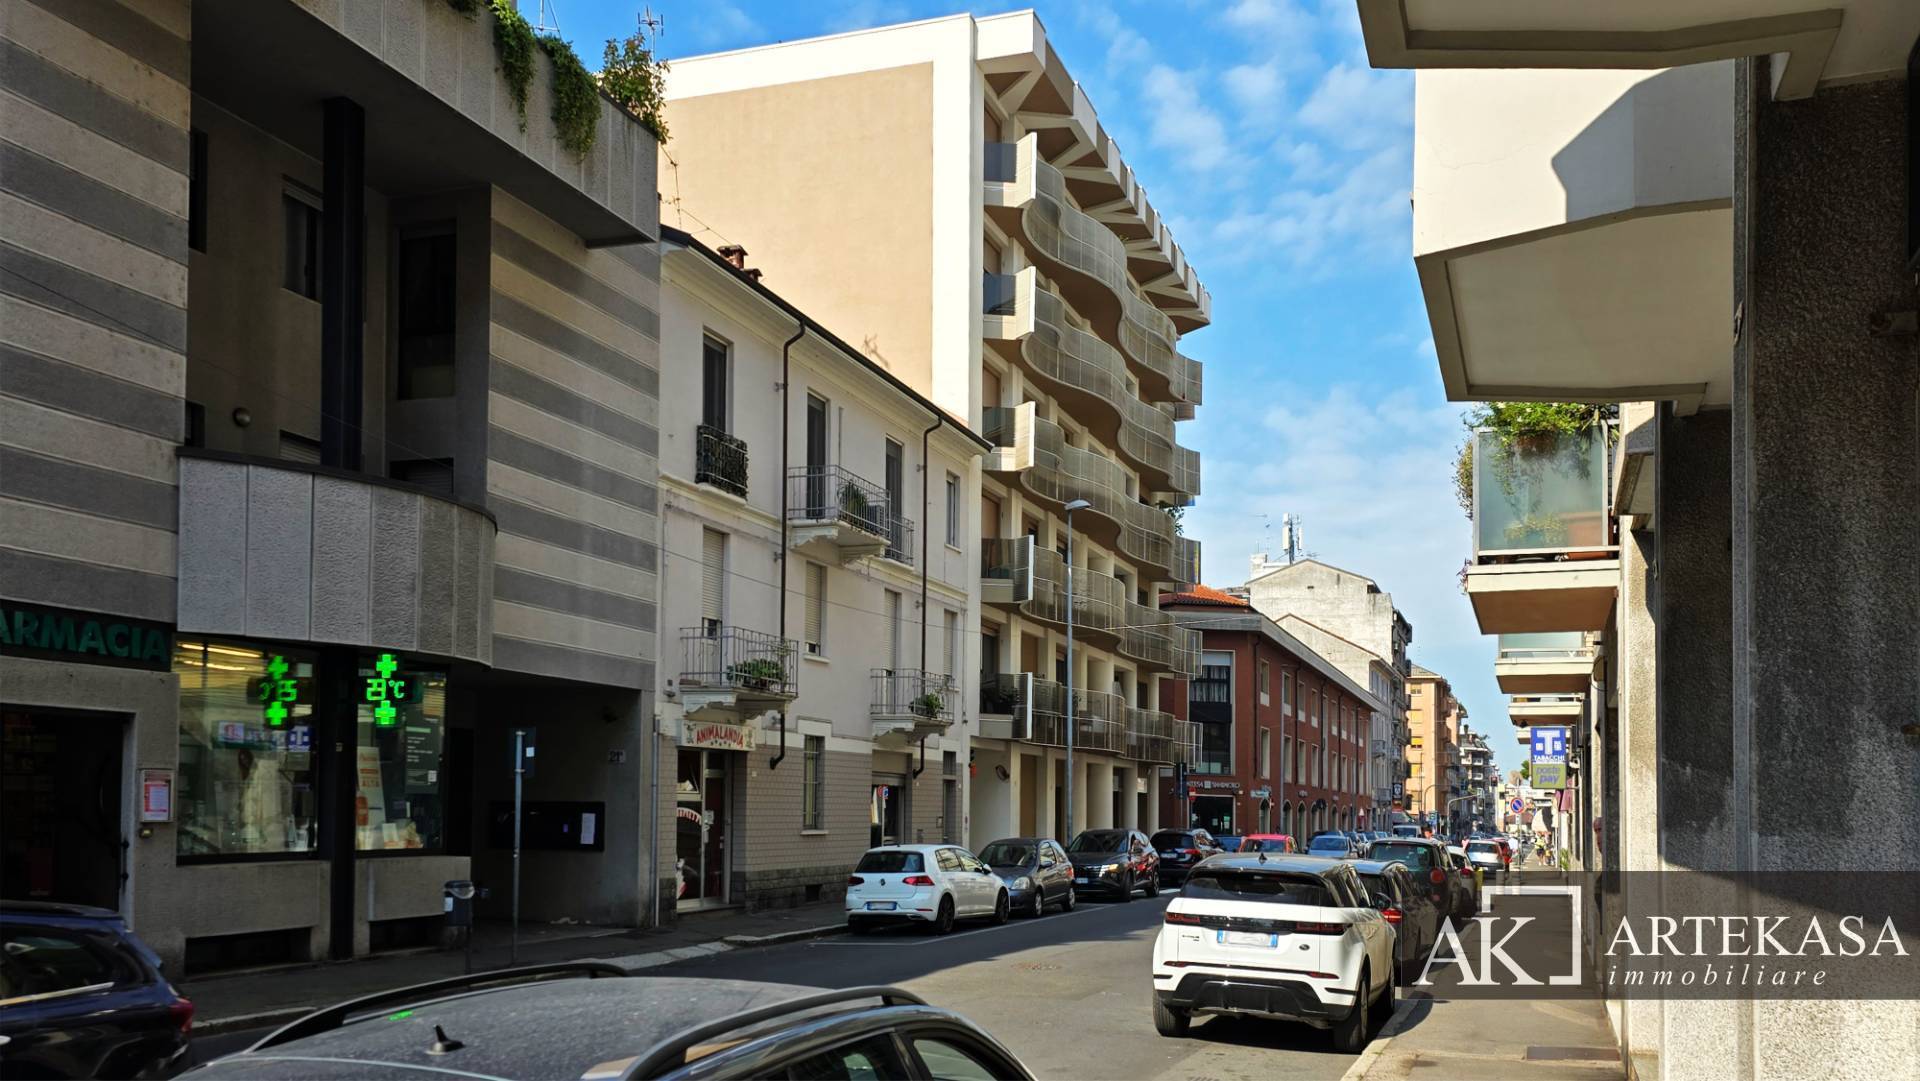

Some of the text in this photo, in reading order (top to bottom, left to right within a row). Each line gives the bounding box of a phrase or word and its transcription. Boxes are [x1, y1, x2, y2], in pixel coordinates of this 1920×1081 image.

[0, 608, 168, 662] RMACIA
[696, 723, 744, 748] ANIMALANDIA
[1539, 774, 1560, 785] pay
